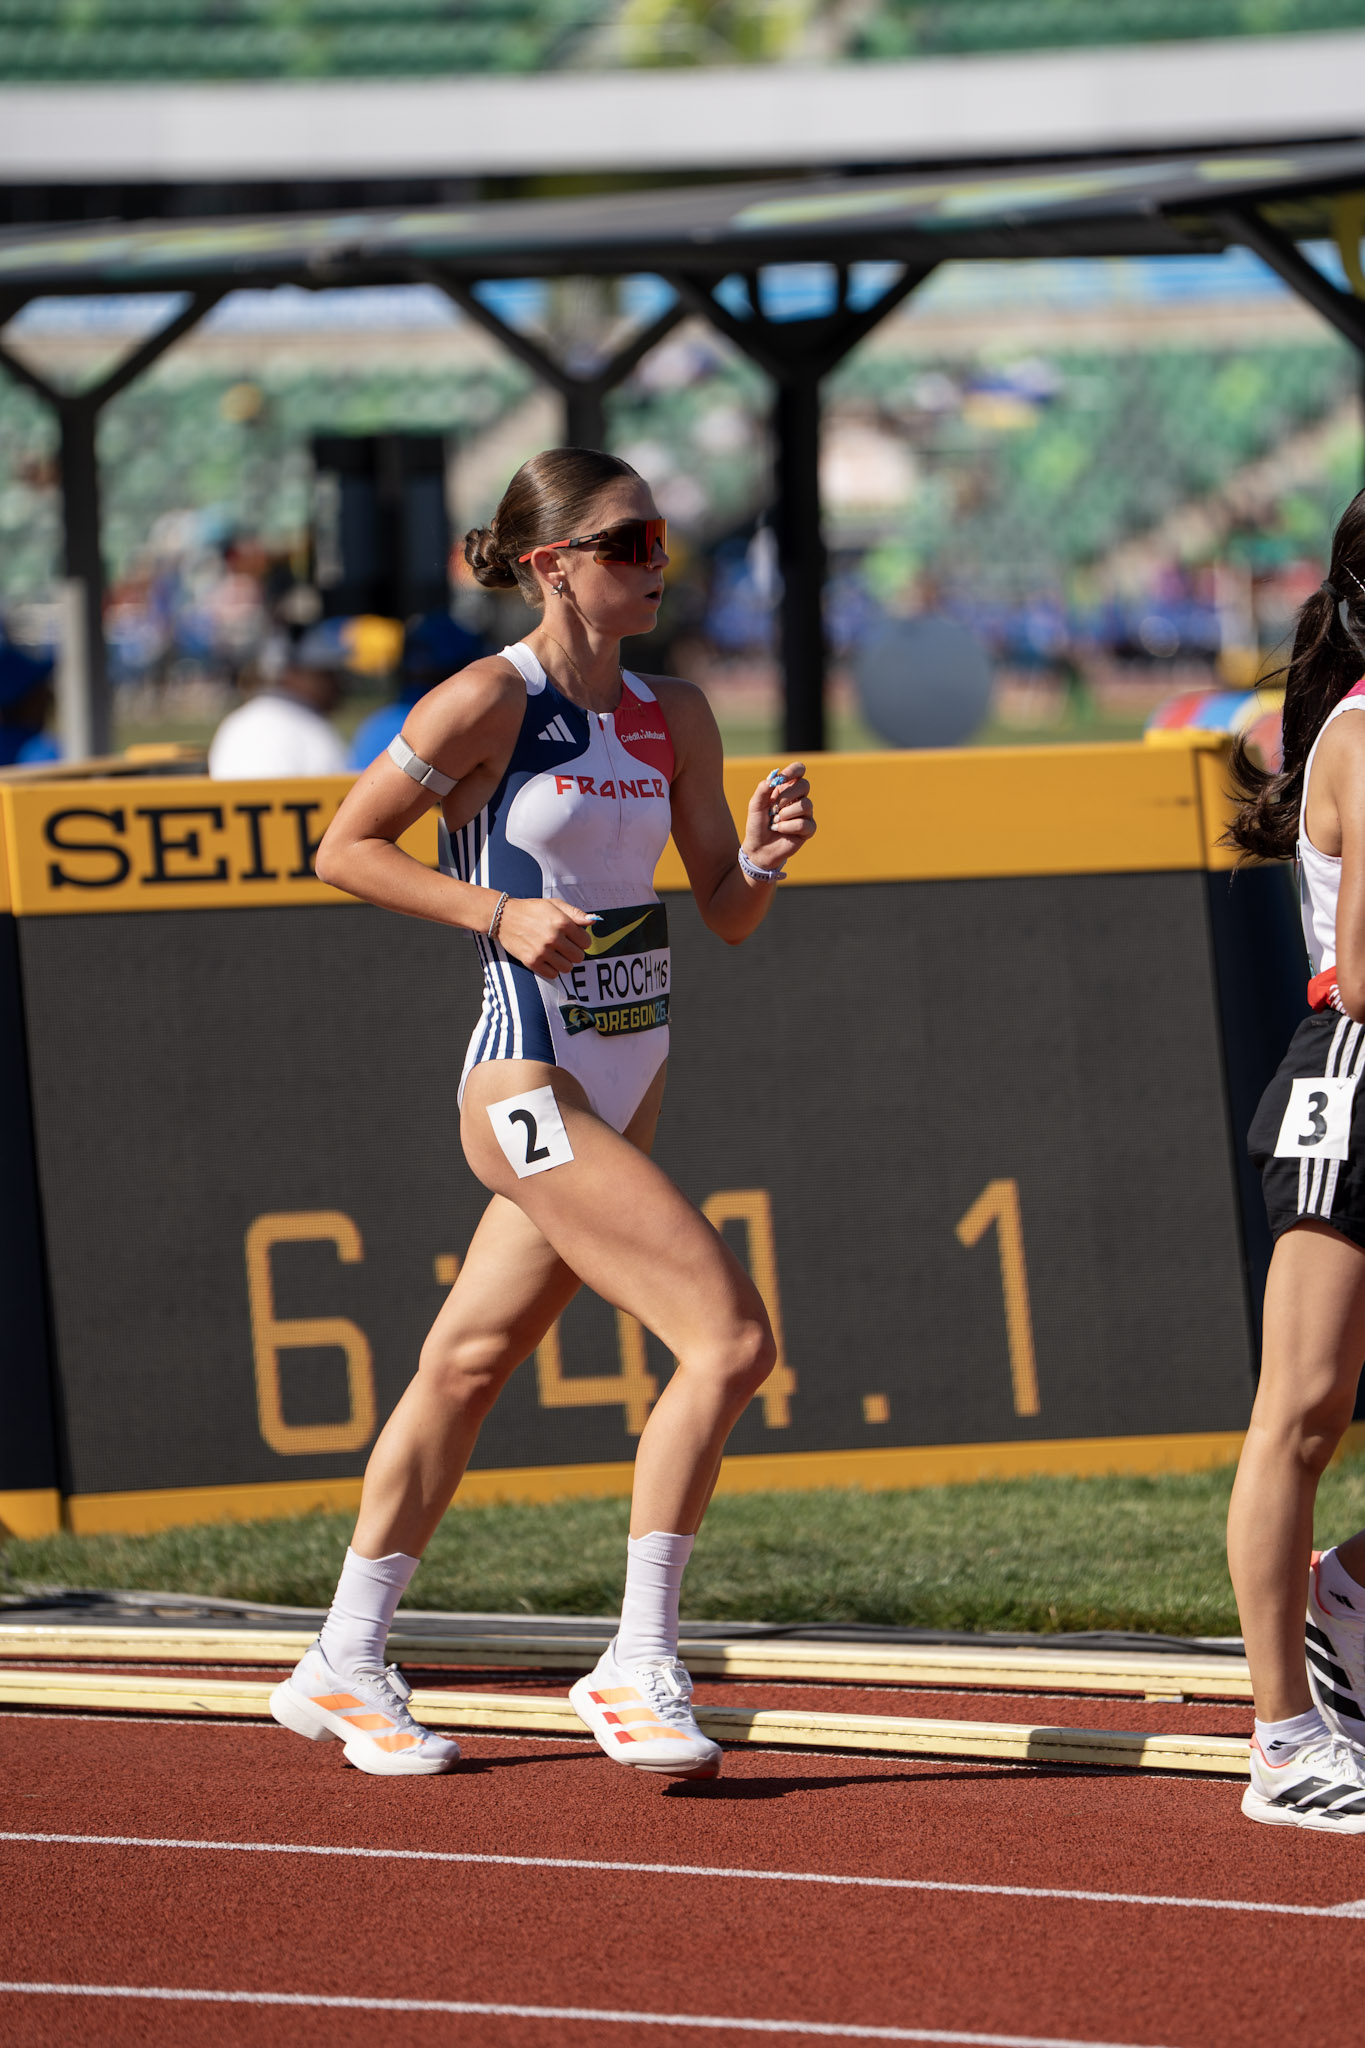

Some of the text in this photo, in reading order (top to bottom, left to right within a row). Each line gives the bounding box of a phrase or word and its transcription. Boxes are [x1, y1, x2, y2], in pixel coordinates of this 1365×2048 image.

[645, 730, 666, 741] Mutuel
[555, 775, 665, 800] FRANCE
[42, 802, 342, 892] SEIK
[558, 965, 589, 1002] LE
[508, 1109, 550, 1164] 2
[1297, 1091, 1329, 1146] 3
